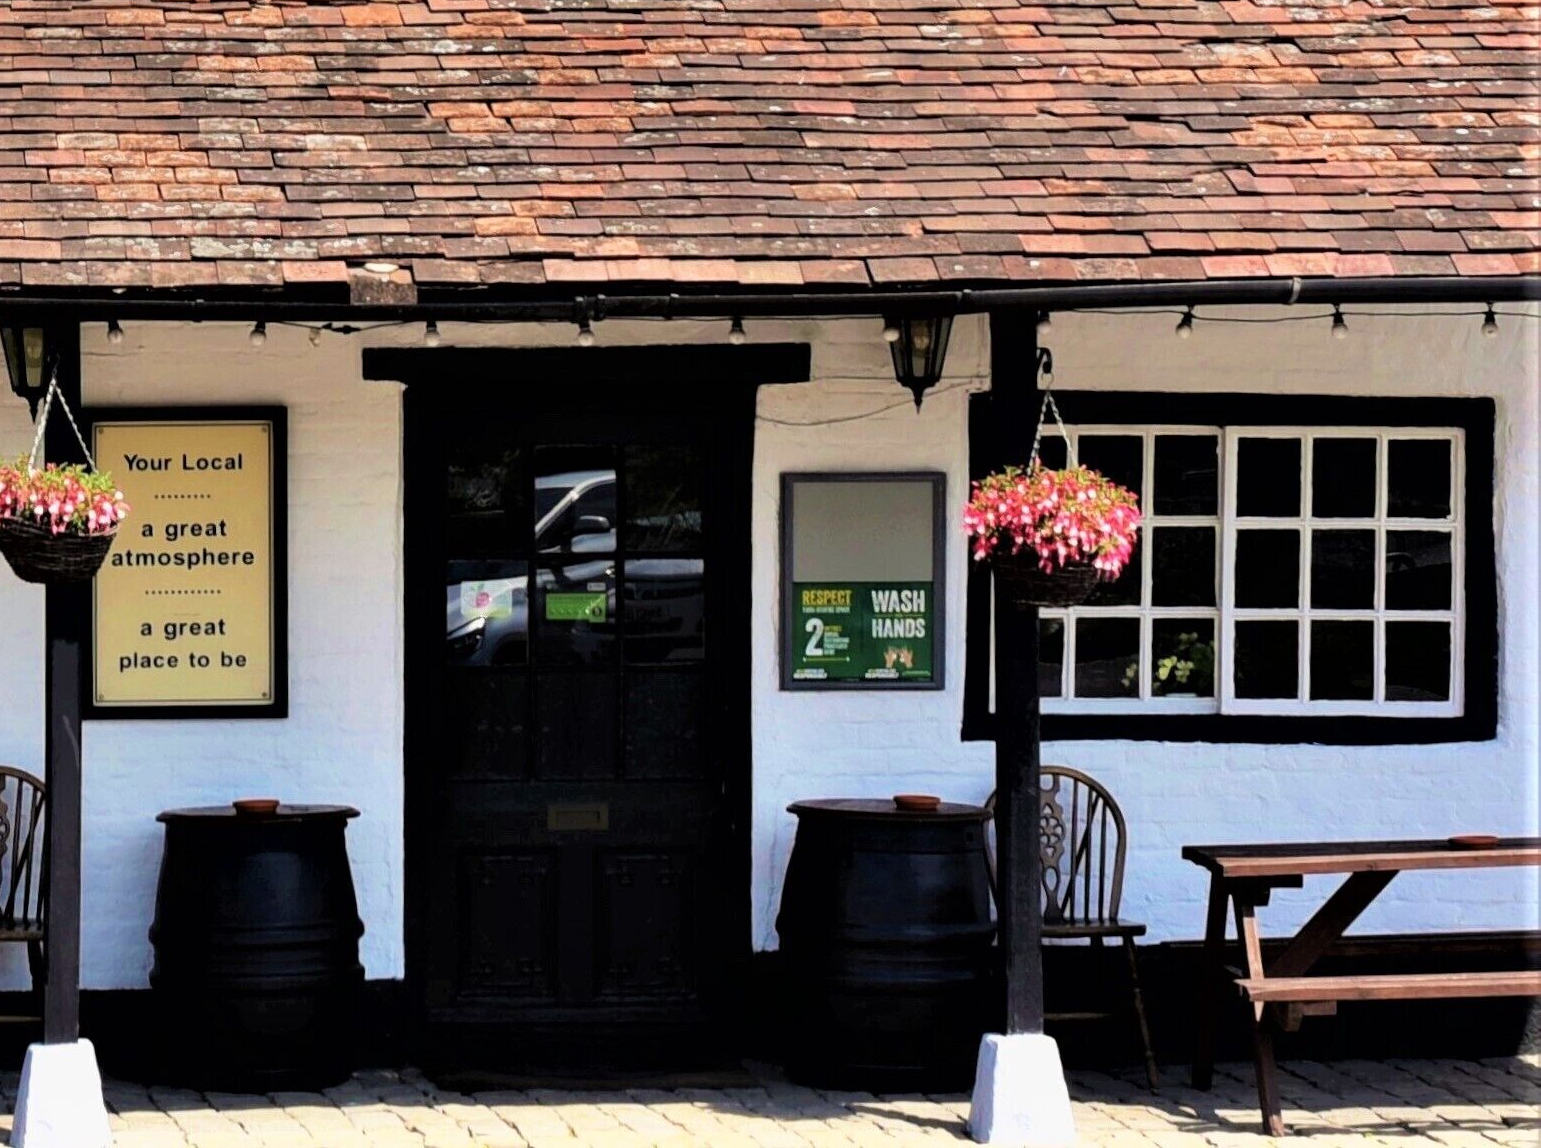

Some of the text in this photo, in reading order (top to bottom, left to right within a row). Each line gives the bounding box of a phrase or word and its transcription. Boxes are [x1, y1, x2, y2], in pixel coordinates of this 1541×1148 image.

[124, 453, 243, 472] Your Local
[141, 519, 228, 542] a great
[111, 547, 255, 570] atmosphere
[802, 590, 852, 606] RESPECT
[871, 589, 926, 613] WASH
[140, 618, 226, 641] a great
[805, 617, 824, 656] 2
[871, 618, 926, 639] HANDS
[119, 651, 247, 674] place to be
